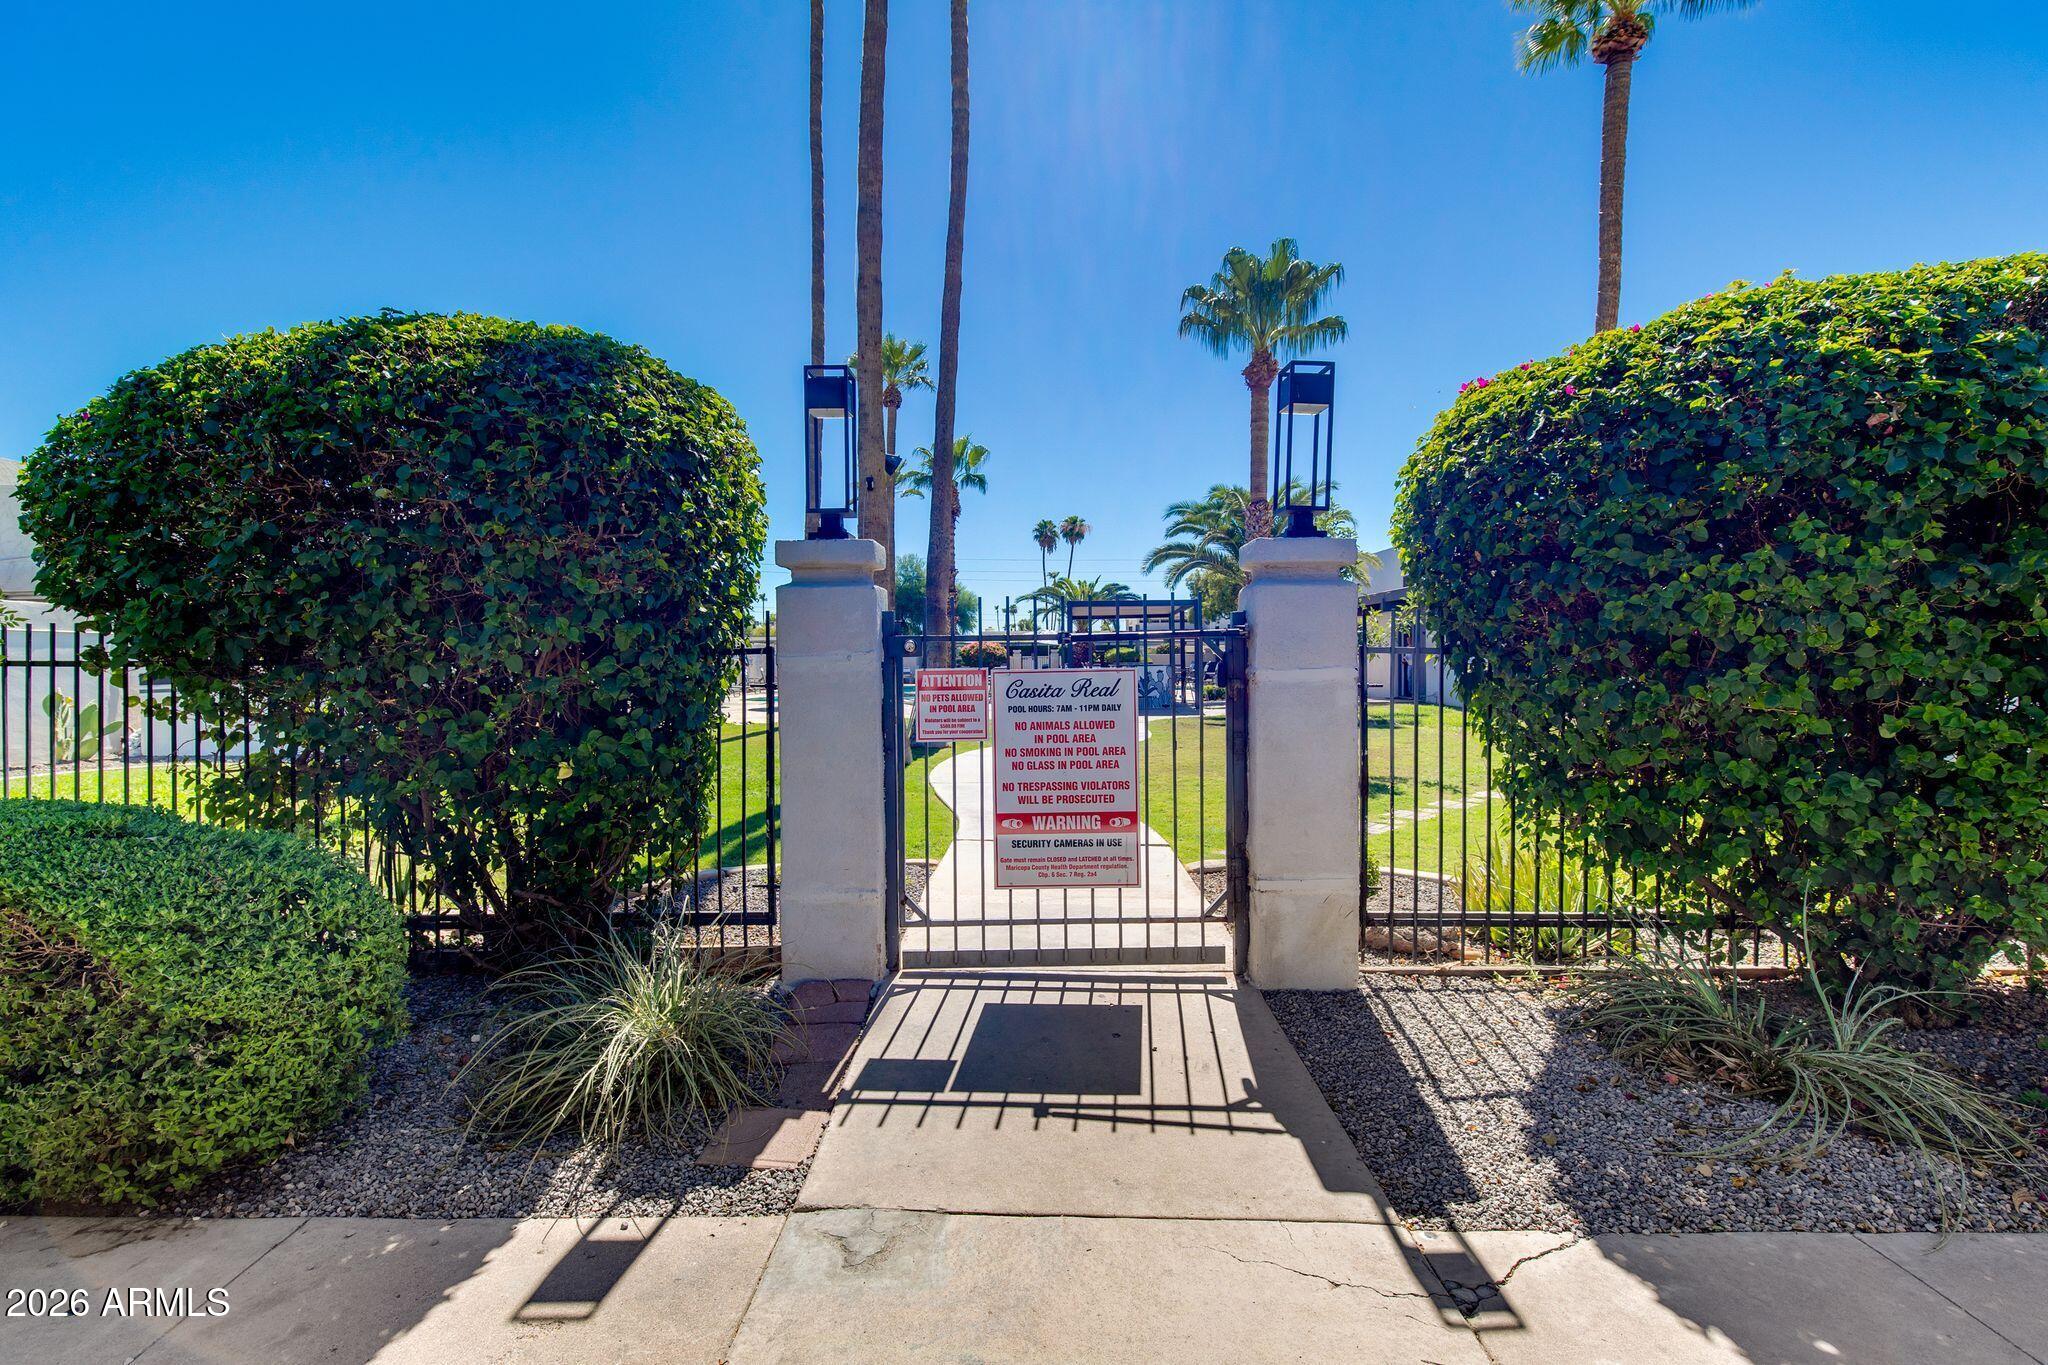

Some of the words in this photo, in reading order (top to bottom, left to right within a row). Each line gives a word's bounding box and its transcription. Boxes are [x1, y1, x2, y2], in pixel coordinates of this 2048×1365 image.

[921, 674, 982, 687] ATTENTION
[1006, 679, 1066, 699] Casita
[1071, 678, 1122, 698] Real
[921, 694, 931, 702] NO
[933, 694, 950, 702] PETS
[950, 694, 983, 702] ALLOWED
[930, 705, 936, 713] IN
[1028, 705, 1054, 713] HOURS:
[1080, 704, 1099, 712] 11PM
[1102, 704, 1122, 712] DAILY
[1015, 722, 1027, 731] NO
[1030, 721, 1070, 730] ANIMALS
[1074, 720, 1115, 730] ALLOWED
[1035, 735, 1043, 743] IN
[1047, 734, 1069, 743] POOL
[1072, 734, 1096, 743] AREA
[1005, 749, 1017, 757] NO
[1020, 748, 1061, 757] SMOKING
[1064, 747, 1073, 756] IN
[1077, 747, 1099, 756] POOL
[1102, 747, 1126, 756] AREA
[1012, 762, 1024, 770] NO
[1027, 761, 1055, 770] GLASS
[1058, 761, 1067, 770] IN
[1070, 760, 1093, 770] POOL
[1096, 760, 1119, 769] AREA
[1003, 782, 1014, 791] NO
[1017, 781, 1078, 791] TRESPASSING
[1081, 781, 1130, 791] VIOLATORS
[1018, 795, 1039, 804] WILL
[1042, 795, 1053, 804] BE
[1057, 794, 1115, 804] PROSECUTED
[1032, 815, 1101, 830] WARNING
[1012, 839, 1051, 848] SECURITY
[1054, 839, 1093, 848] CAMERAS
[1097, 839, 1105, 847] IN
[1107, 839, 1122, 847] USE
